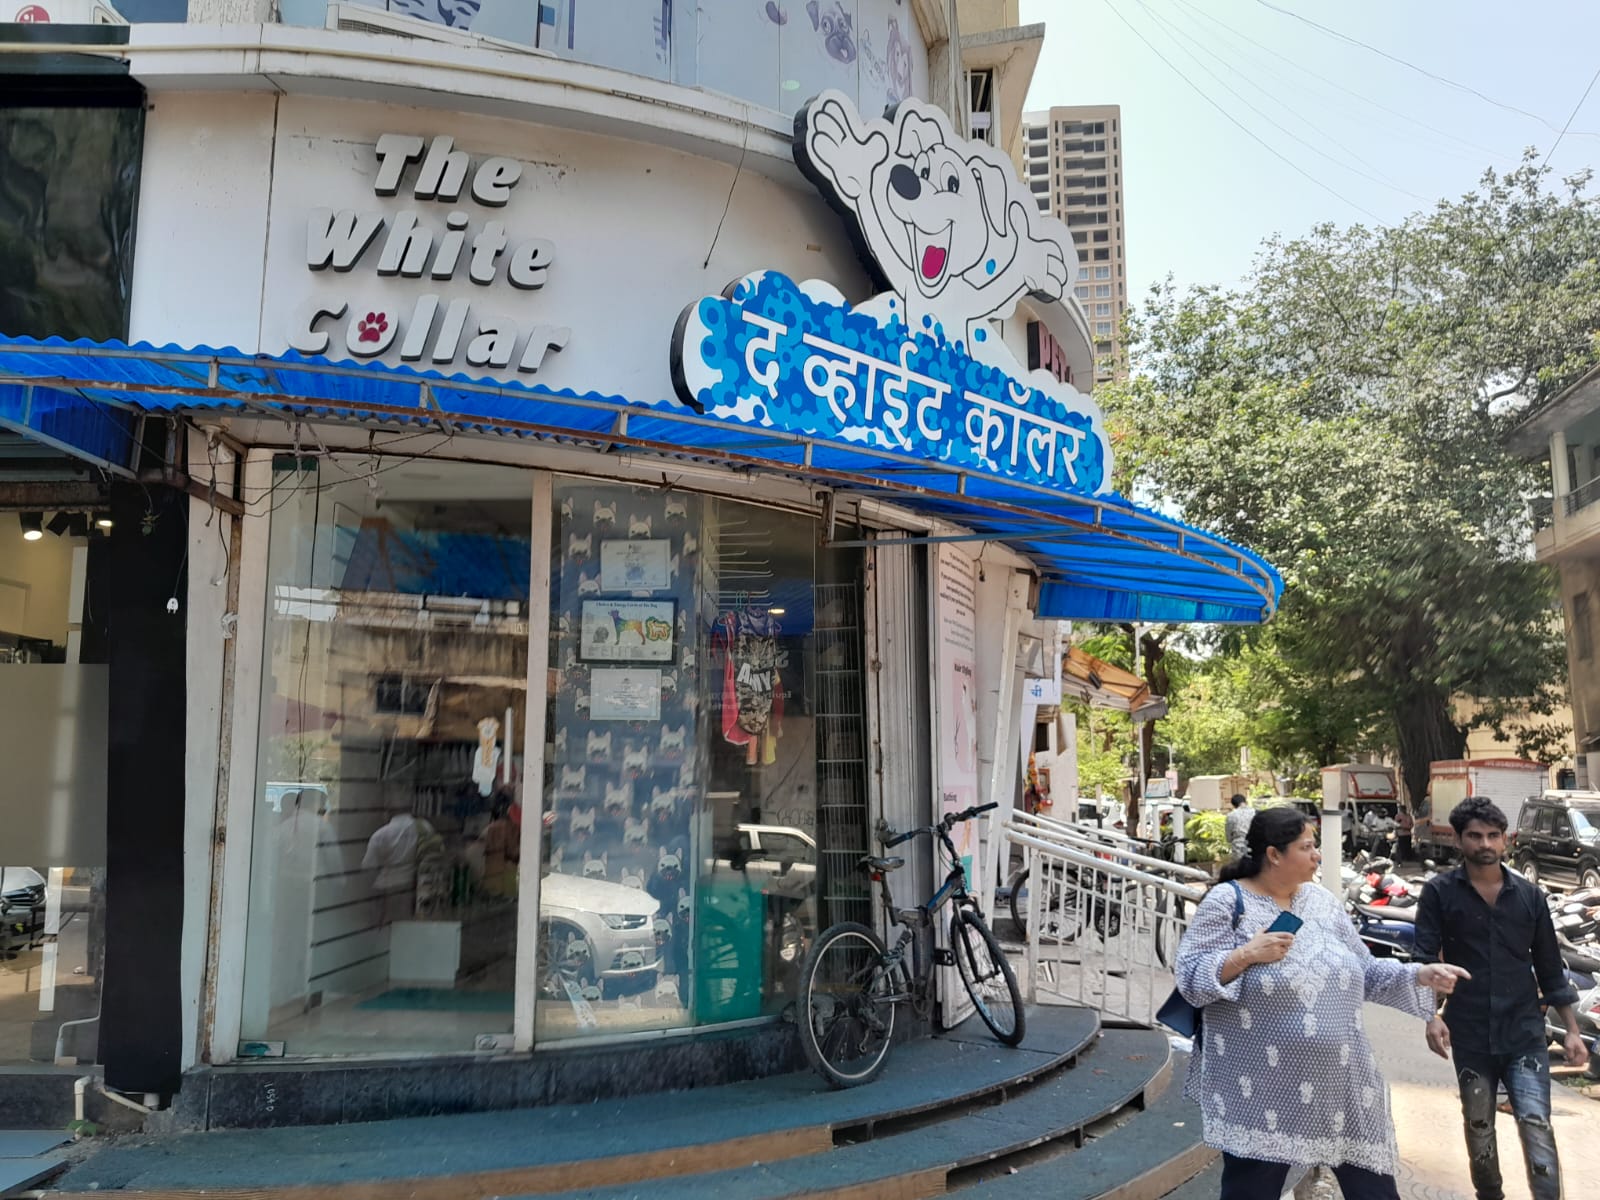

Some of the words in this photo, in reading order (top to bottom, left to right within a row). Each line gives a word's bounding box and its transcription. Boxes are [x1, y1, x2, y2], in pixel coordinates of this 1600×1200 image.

[374, 133, 523, 208] The
[306, 207, 557, 291] White
[288, 293, 573, 374] Collar
[741, 311, 788, 400] द
[801, 331, 952, 451] व्हाईट
[963, 381, 1086, 484] कॉलर
